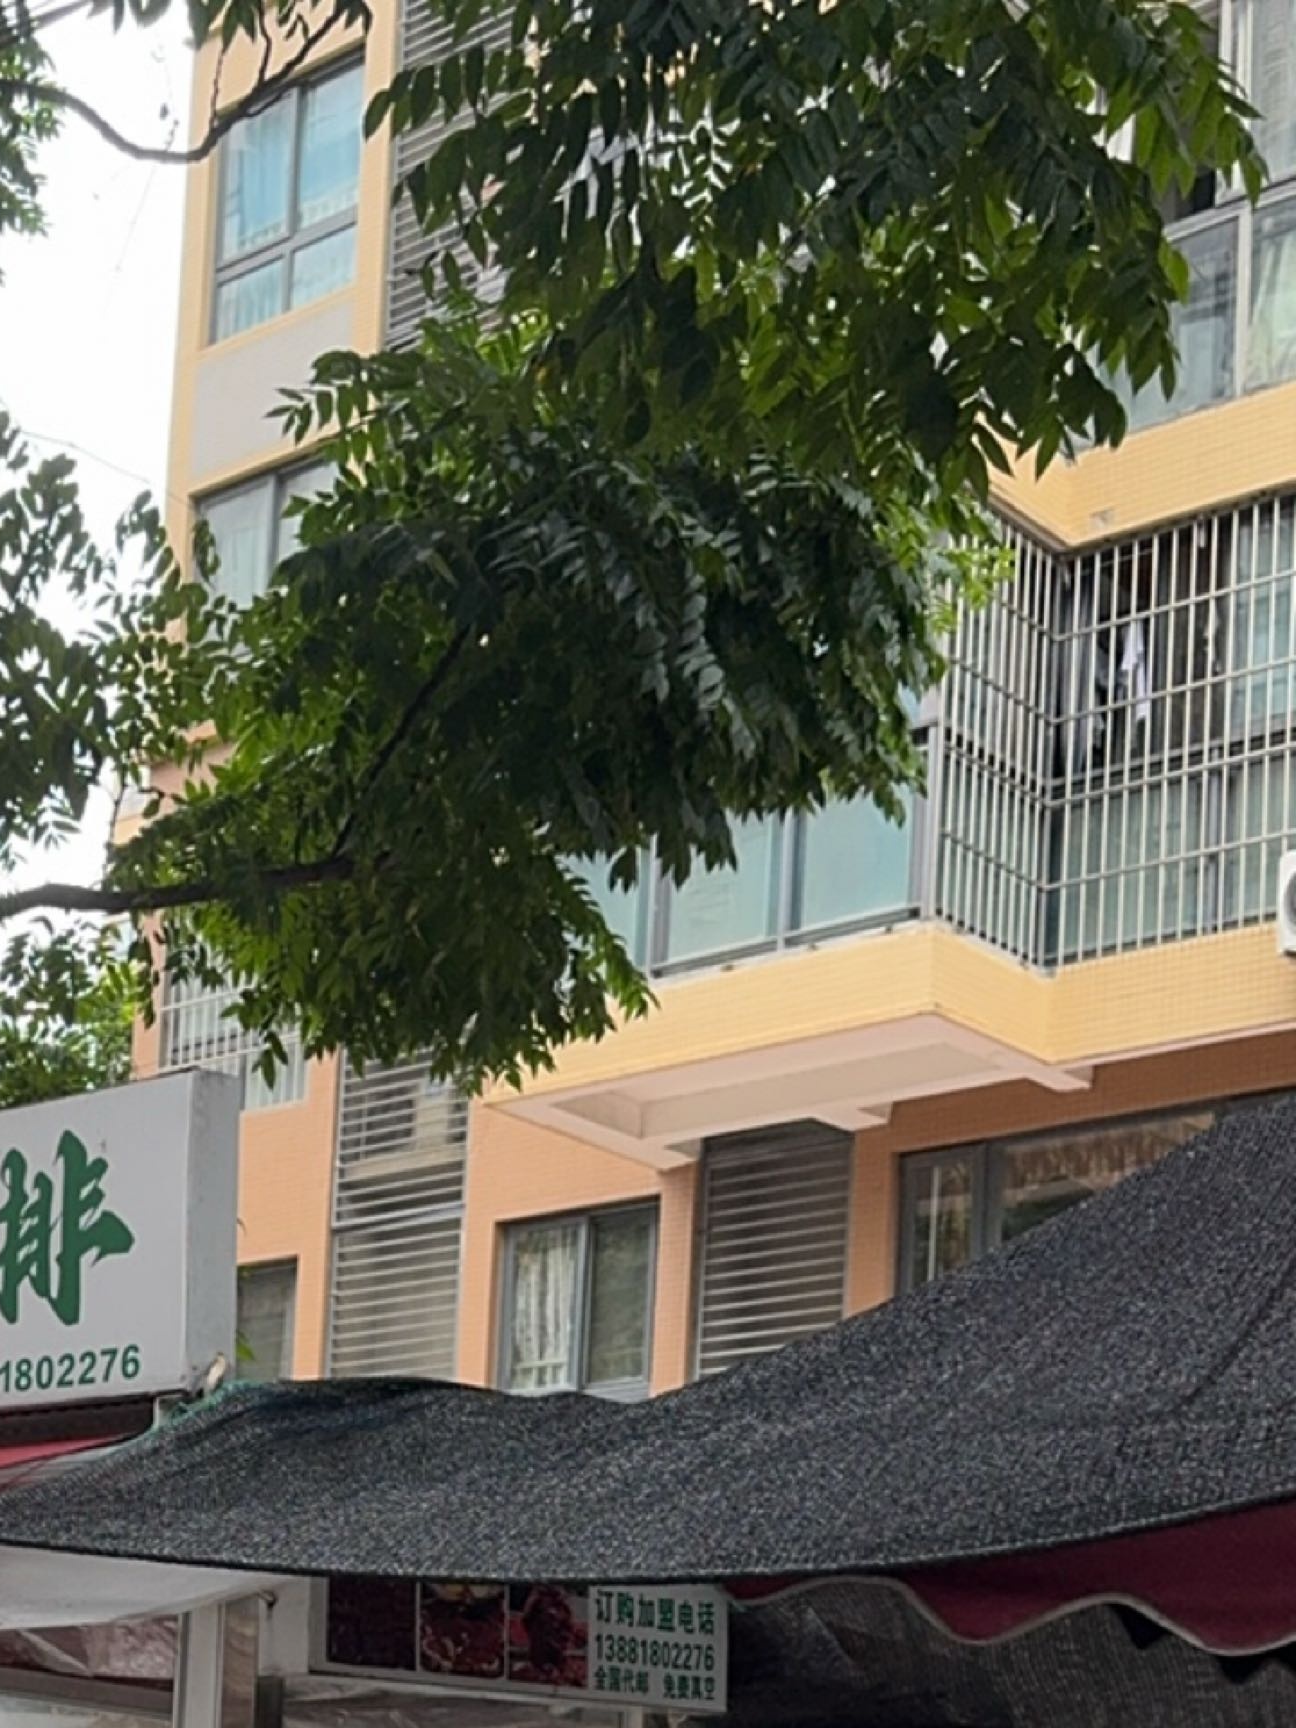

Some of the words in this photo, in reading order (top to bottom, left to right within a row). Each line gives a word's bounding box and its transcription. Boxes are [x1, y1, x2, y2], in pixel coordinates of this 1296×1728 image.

[595, 1589, 715, 1635] 订购加盟电话
[595, 1633, 715, 1672] 13881802276
